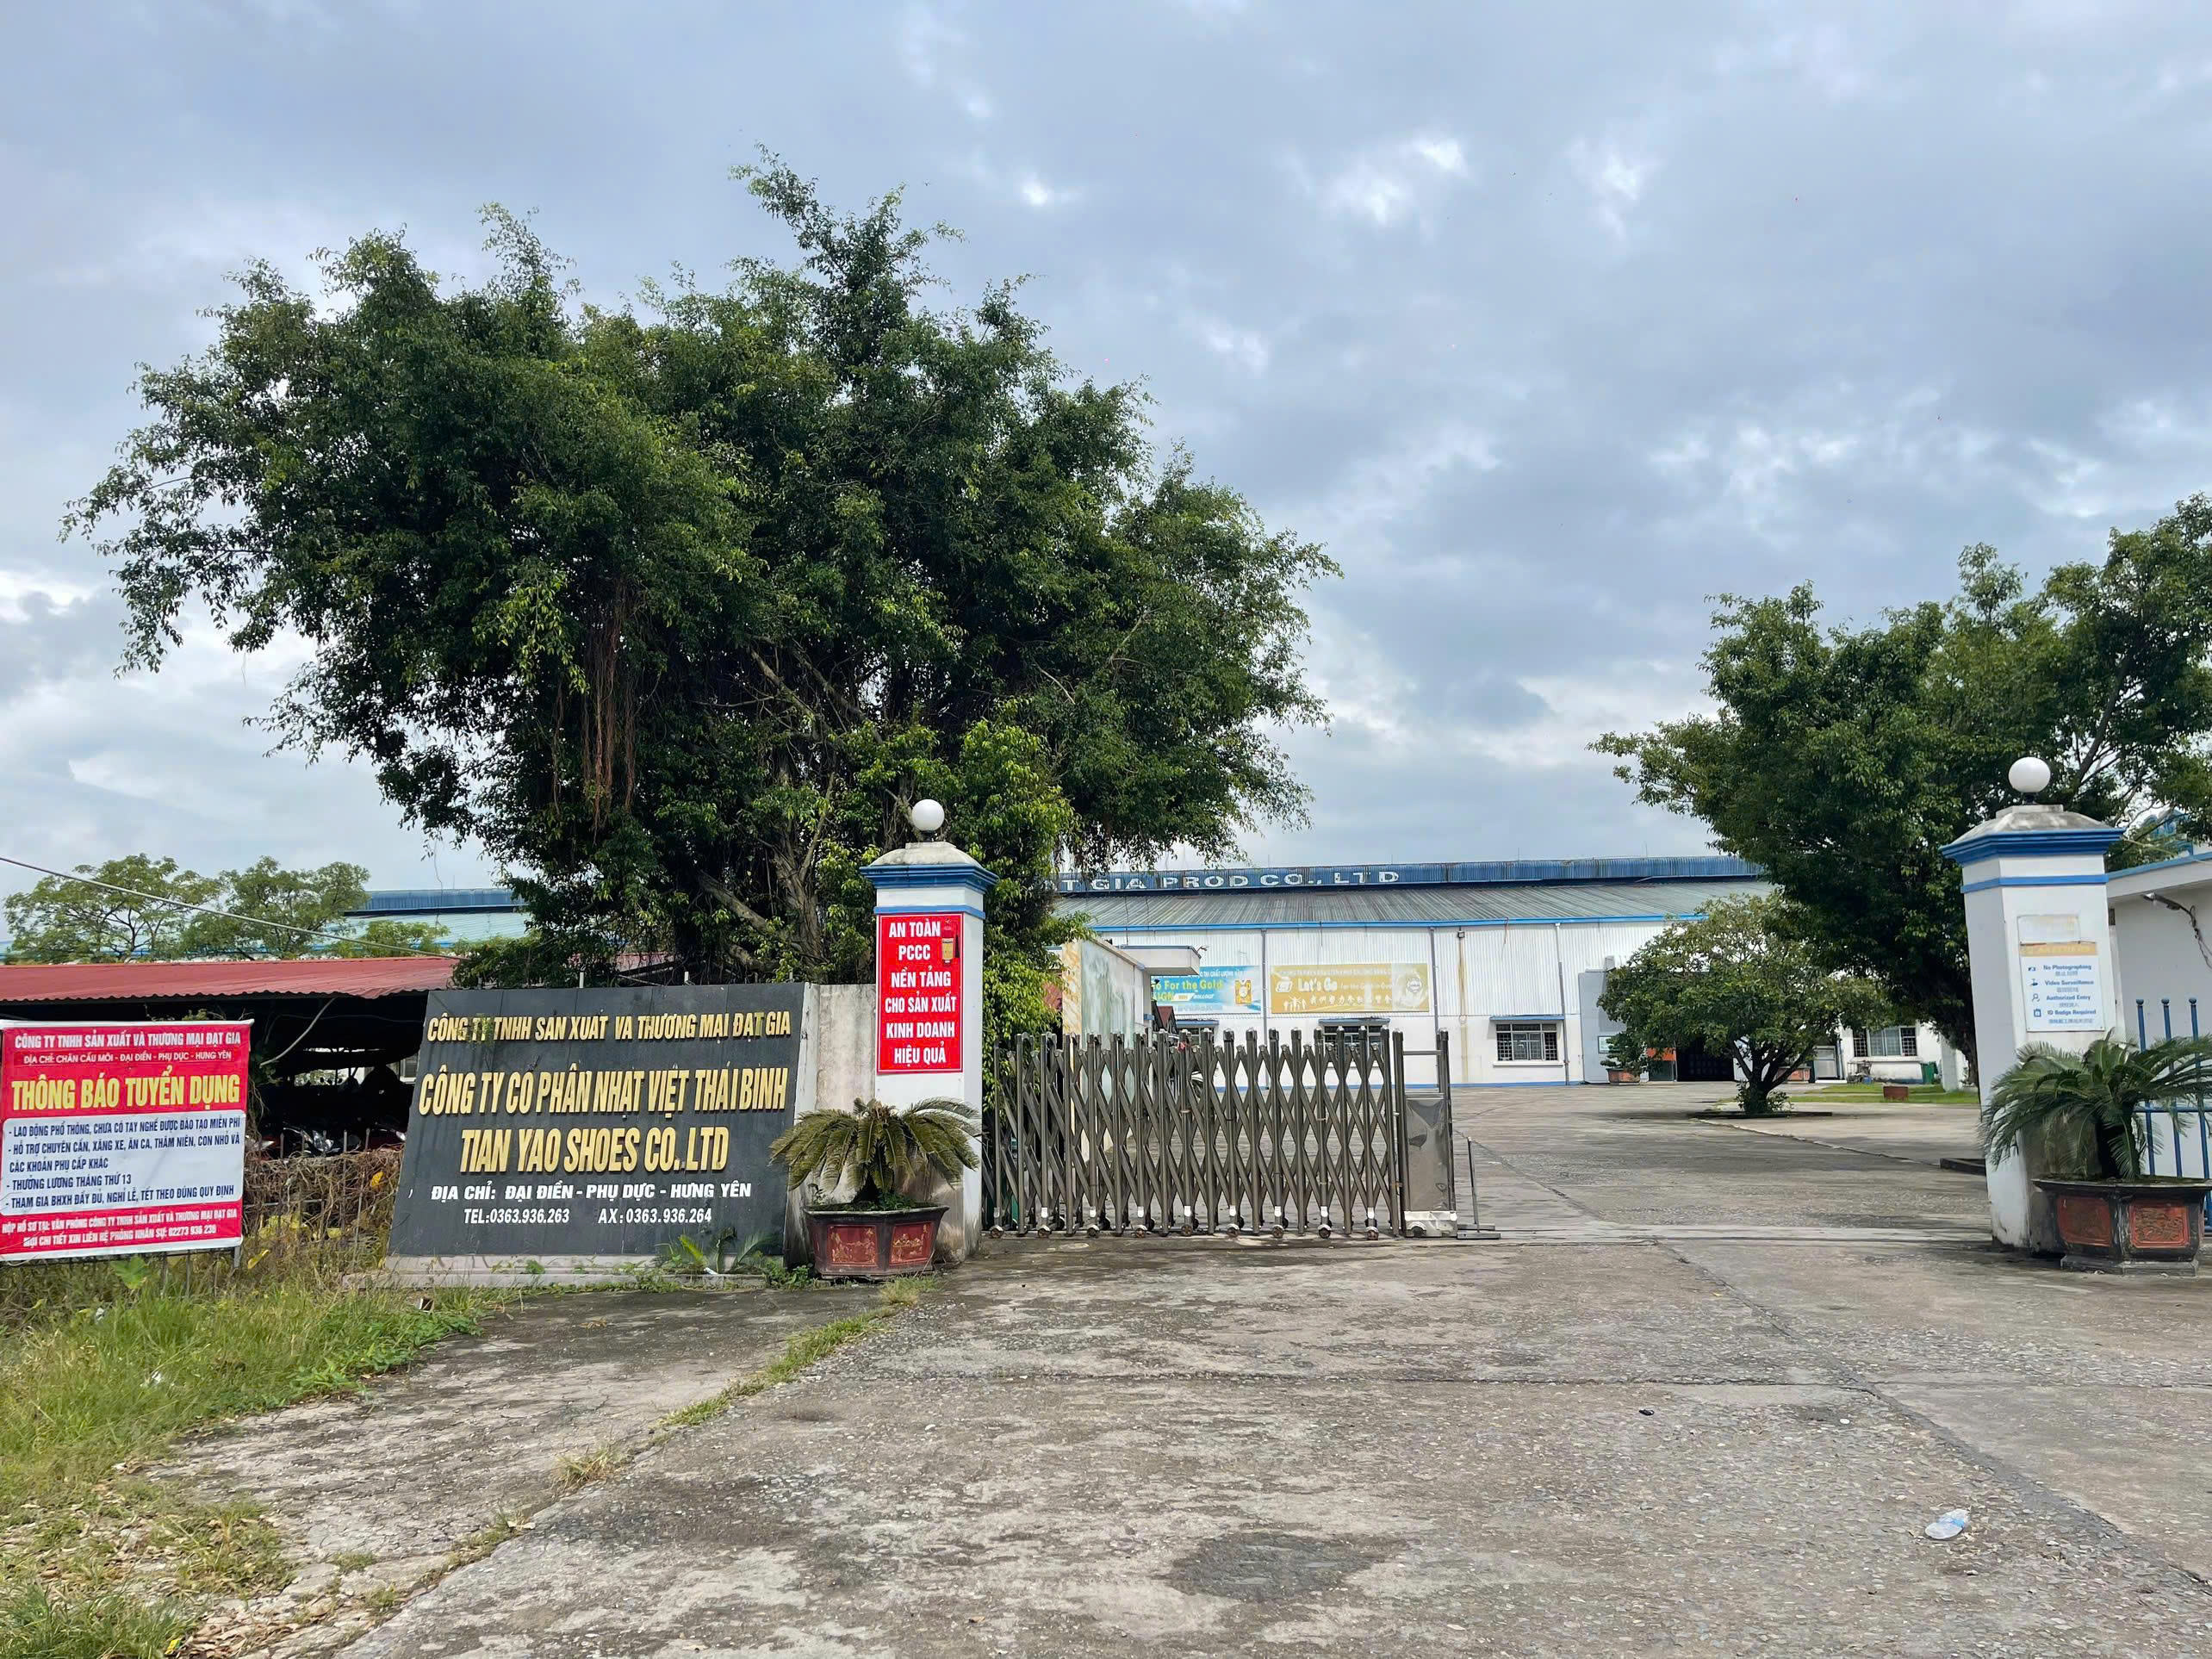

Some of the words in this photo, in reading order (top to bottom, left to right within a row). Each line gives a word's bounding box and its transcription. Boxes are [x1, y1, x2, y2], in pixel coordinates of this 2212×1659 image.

[1091, 877, 1146, 890] GIA
[1163, 875, 1248, 888] PROD
[1334, 871, 1399, 884] LTD
[889, 923, 905, 938] AN
[910, 919, 941, 938] TOÀN
[898, 944, 930, 961] PCCC
[892, 966, 916, 988] NỀN
[919, 966, 951, 987] TẢNG
[885, 997, 904, 1013] CHO
[908, 992, 928, 1013] SẢN
[931, 992, 956, 1013] XUẤT
[427, 1012, 469, 1041] CÔNG
[494, 1016, 532, 1041] TNHH
[637, 1013, 697, 1040] THƯƠNG
[699, 1013, 730, 1044] MẠI
[733, 1012, 765, 1043] ĐẠT
[766, 1010, 791, 1035] GIA
[886, 1022, 912, 1039] KINH
[916, 1022, 955, 1038] DOANH
[15, 1033, 41, 1048] CÔNG
[44, 1035, 56, 1048] TY
[58, 1035, 83, 1048] TNHH
[84, 1029, 104, 1048] SẢN
[107, 1029, 131, 1047] XUẤT
[134, 1030, 145, 1047] VÀ
[186, 1032, 204, 1047] MẠI
[206, 1032, 223, 1047] ĐẠT
[226, 1032, 240, 1045] GIA
[894, 1045, 920, 1067] HIỆU
[923, 1042, 946, 1065] QUẢ
[11, 1074, 76, 1110] THÔNG
[80, 1072, 120, 1109] BÁO
[125, 1065, 184, 1107] TUYỂN
[190, 1074, 240, 1110] DỤNG
[419, 1064, 475, 1115] CÔNG
[479, 1072, 505, 1114] TY
[694, 1060, 738, 1111] THÁI
[14, 1126, 27, 1137] LAO
[29, 1123, 48, 1139] ĐỘNG
[126, 1122, 138, 1133] TAY
[196, 1119, 208, 1132] TẠO
[41, 1140, 71, 1153] CHUYÊN
[197, 1135, 212, 1146] CON
[231, 1132, 239, 1144] VÀ
[460, 1129, 512, 1173] TIAN
[517, 1128, 562, 1172] YAO
[563, 1128, 640, 1172] SHOES
[9, 1159, 25, 1172] CÁC
[27, 1156, 53, 1171] KHOẢN
[54, 1159, 70, 1172] PHỤ
[89, 1157, 109, 1170] KHÁC
[76, 1174, 102, 1187] THÁNG
[122, 1174, 131, 1184] 13
[431, 1185, 458, 1202] ĐỊA
[463, 1180, 496, 1200] CHỈ:
[505, 1184, 531, 1202] ĐẠI
[537, 1180, 574, 1199] ĐIỀN
[586, 1184, 618, 1202] PHỤ
[622, 1183, 655, 1201] DỰC
[670, 1183, 714, 1198] HƯNG
[720, 1180, 751, 1197] YÊN
[11, 1196, 34, 1209] THAM
[35, 1196, 49, 1207] GIA
[52, 1195, 72, 1207] BHXH
[156, 1189, 174, 1200] THEO
[199, 1186, 214, 1197] QUY
[216, 1185, 234, 1198] ĐỊNH
